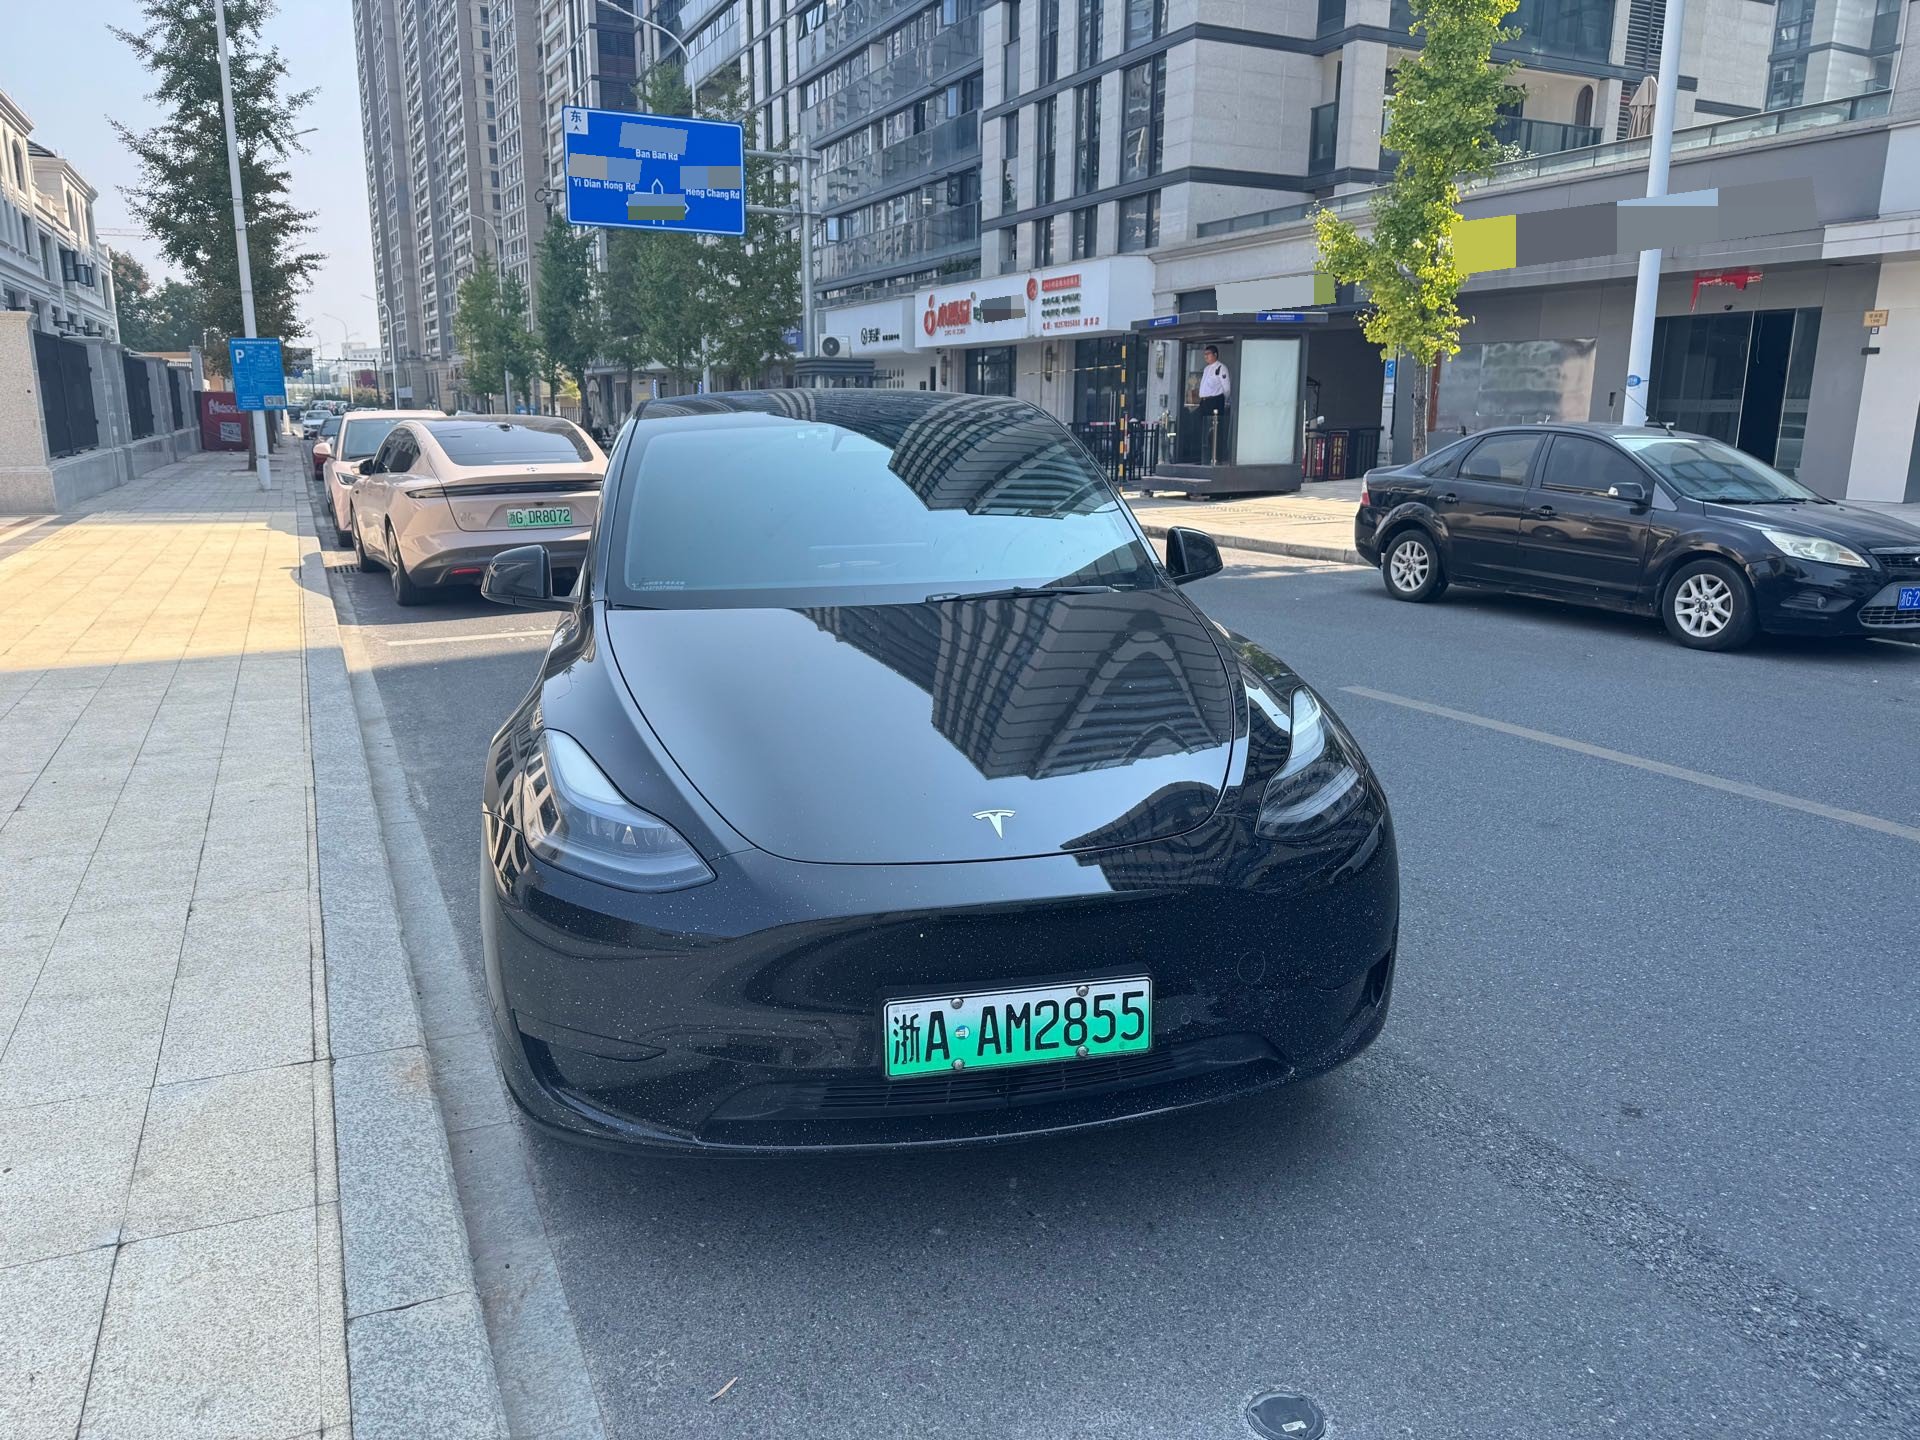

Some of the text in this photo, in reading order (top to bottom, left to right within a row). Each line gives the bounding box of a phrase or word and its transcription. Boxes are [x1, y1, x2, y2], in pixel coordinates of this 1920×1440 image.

[570, 110, 582, 122] 东
[635, 149, 650, 158] Ban
[652, 151, 667, 160] Ban
[573, 178, 636, 192] Yi Dian Hong Rd
[706, 188, 730, 200] Chang
[730, 190, 740, 199] Rd
[235, 349, 245, 364] P
